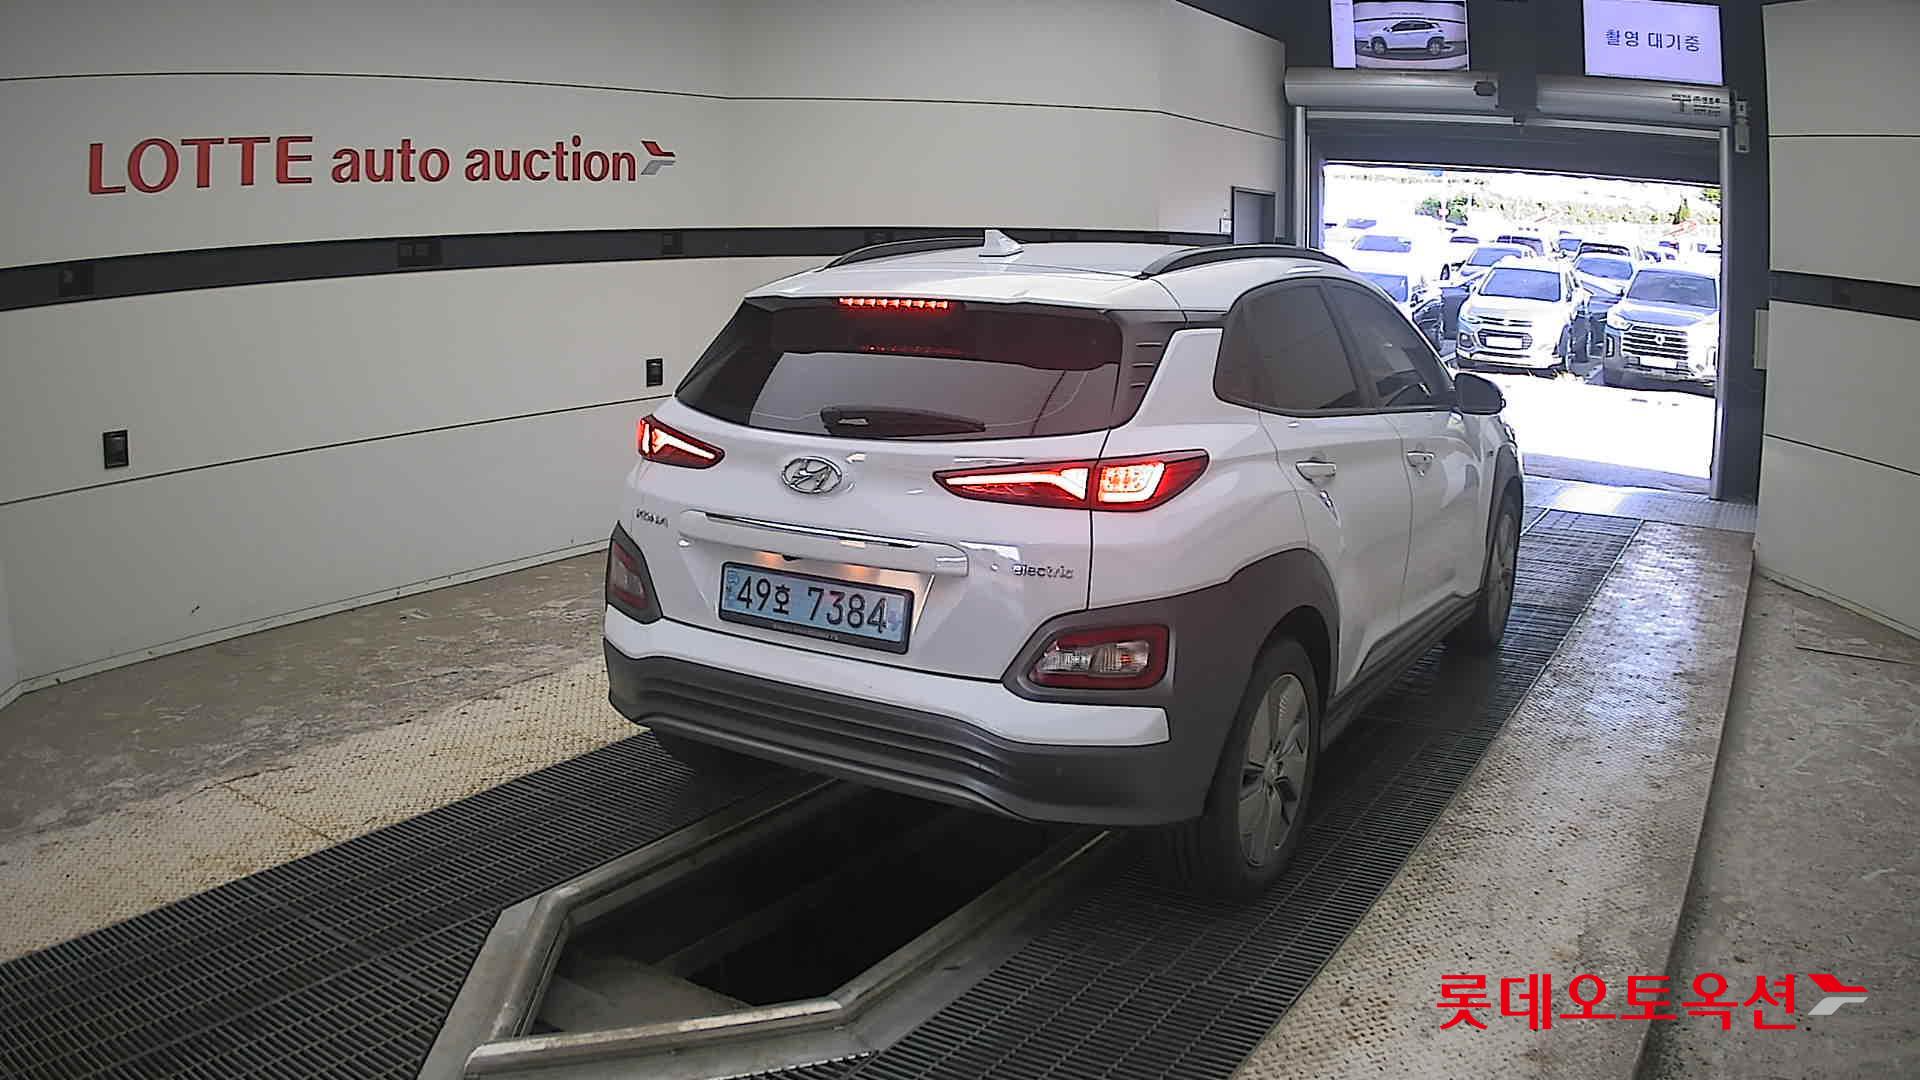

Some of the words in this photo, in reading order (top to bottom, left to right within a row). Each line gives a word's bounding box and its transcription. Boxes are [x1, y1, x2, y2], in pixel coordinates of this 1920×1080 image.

[1648, 32, 1701, 53] 대기중
[88, 135, 313, 195] LOTTE
[331, 138, 450, 184] auto
[465, 135, 637, 183] auction
[1012, 562, 1075, 579] electric
[736, 575, 792, 616] 49호
[807, 586, 888, 634] 7384
